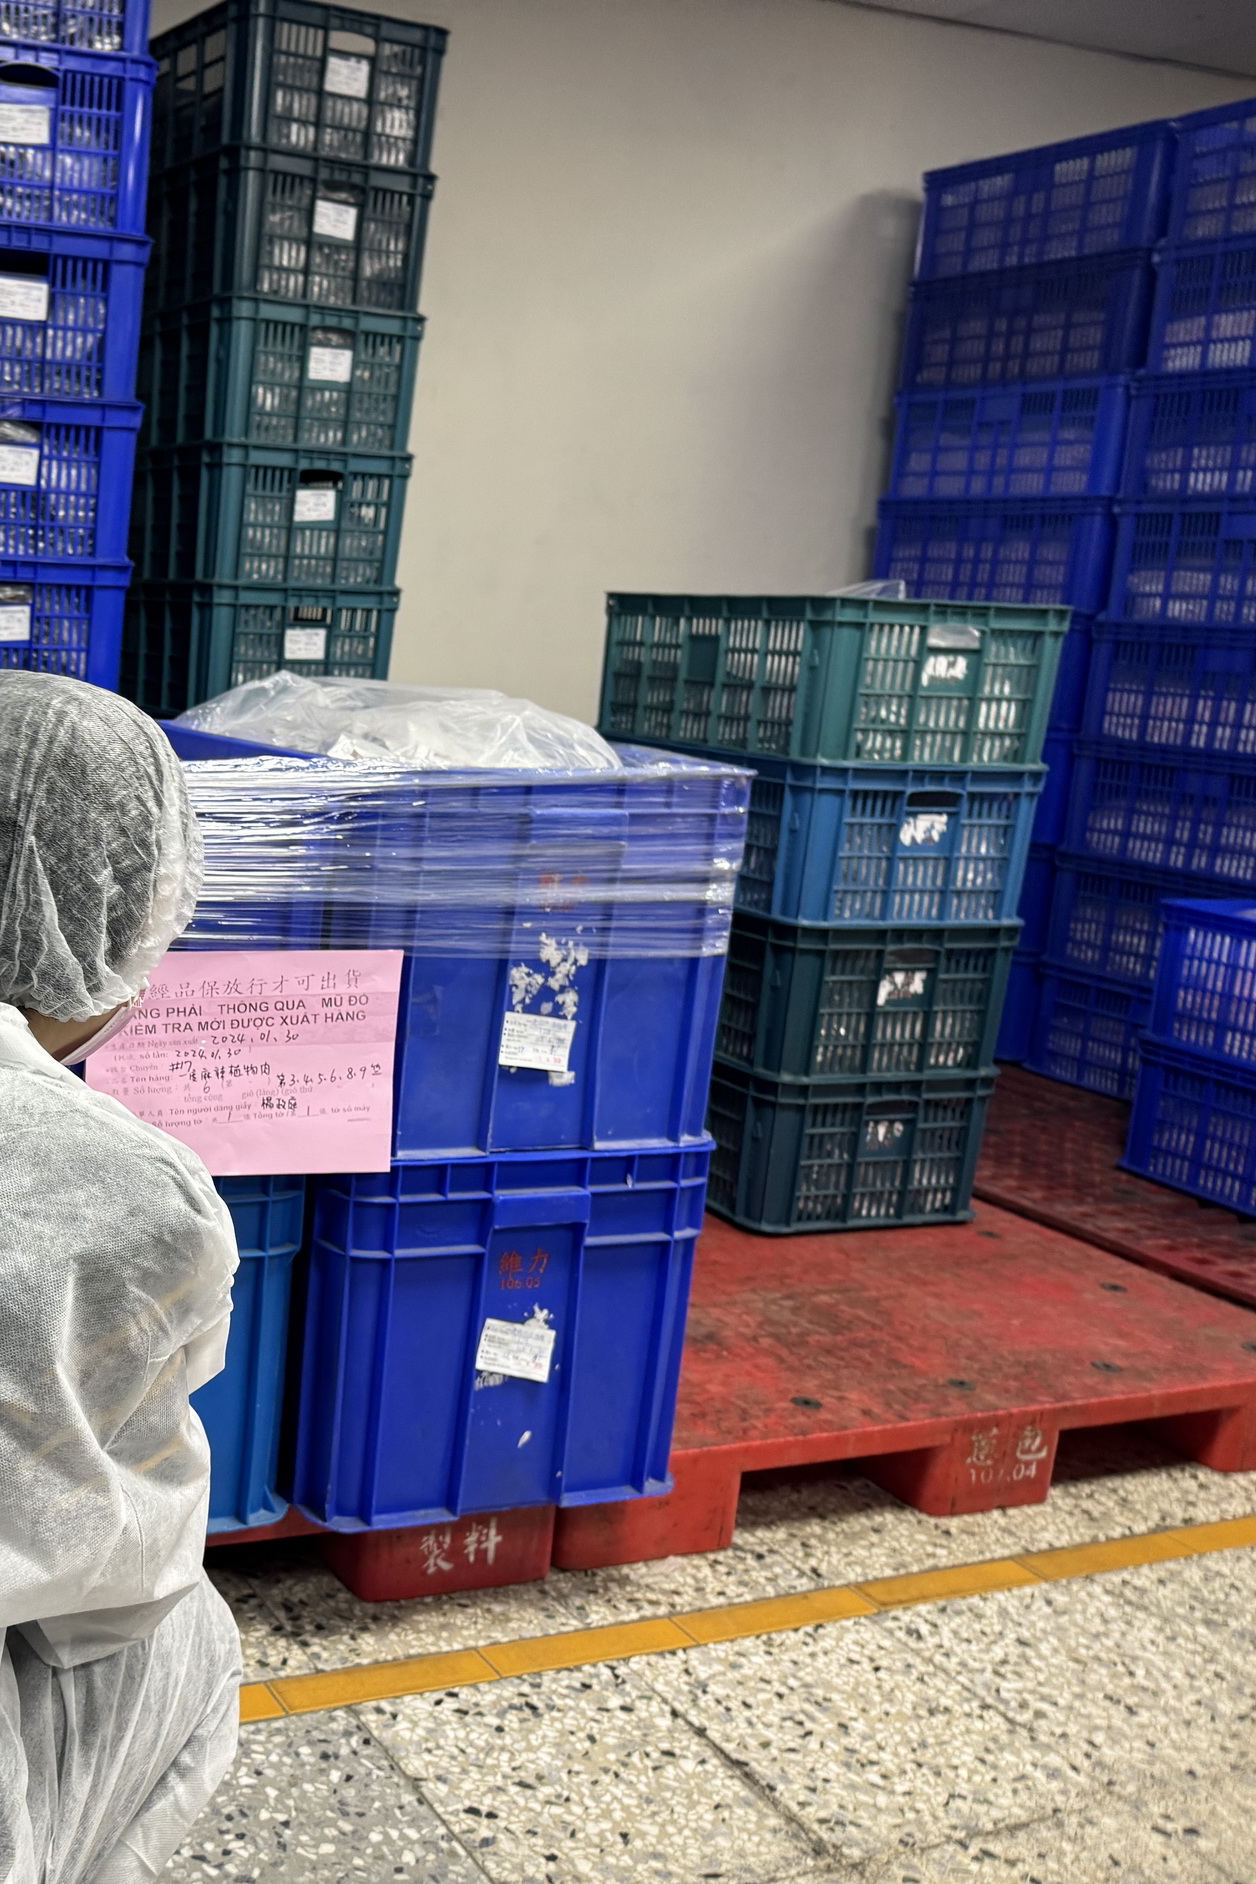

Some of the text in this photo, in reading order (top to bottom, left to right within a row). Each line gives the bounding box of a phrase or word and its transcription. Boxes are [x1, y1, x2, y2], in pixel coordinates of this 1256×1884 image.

[148, 968, 363, 1000] 經品保放行才可出貨
[132, 1008, 161, 1020] NG
[274, 999, 307, 1012] QUA
[161, 1022, 194, 1034] TRA
[498, 1248, 550, 1278] 維力
[419, 1516, 503, 1575] 製料
